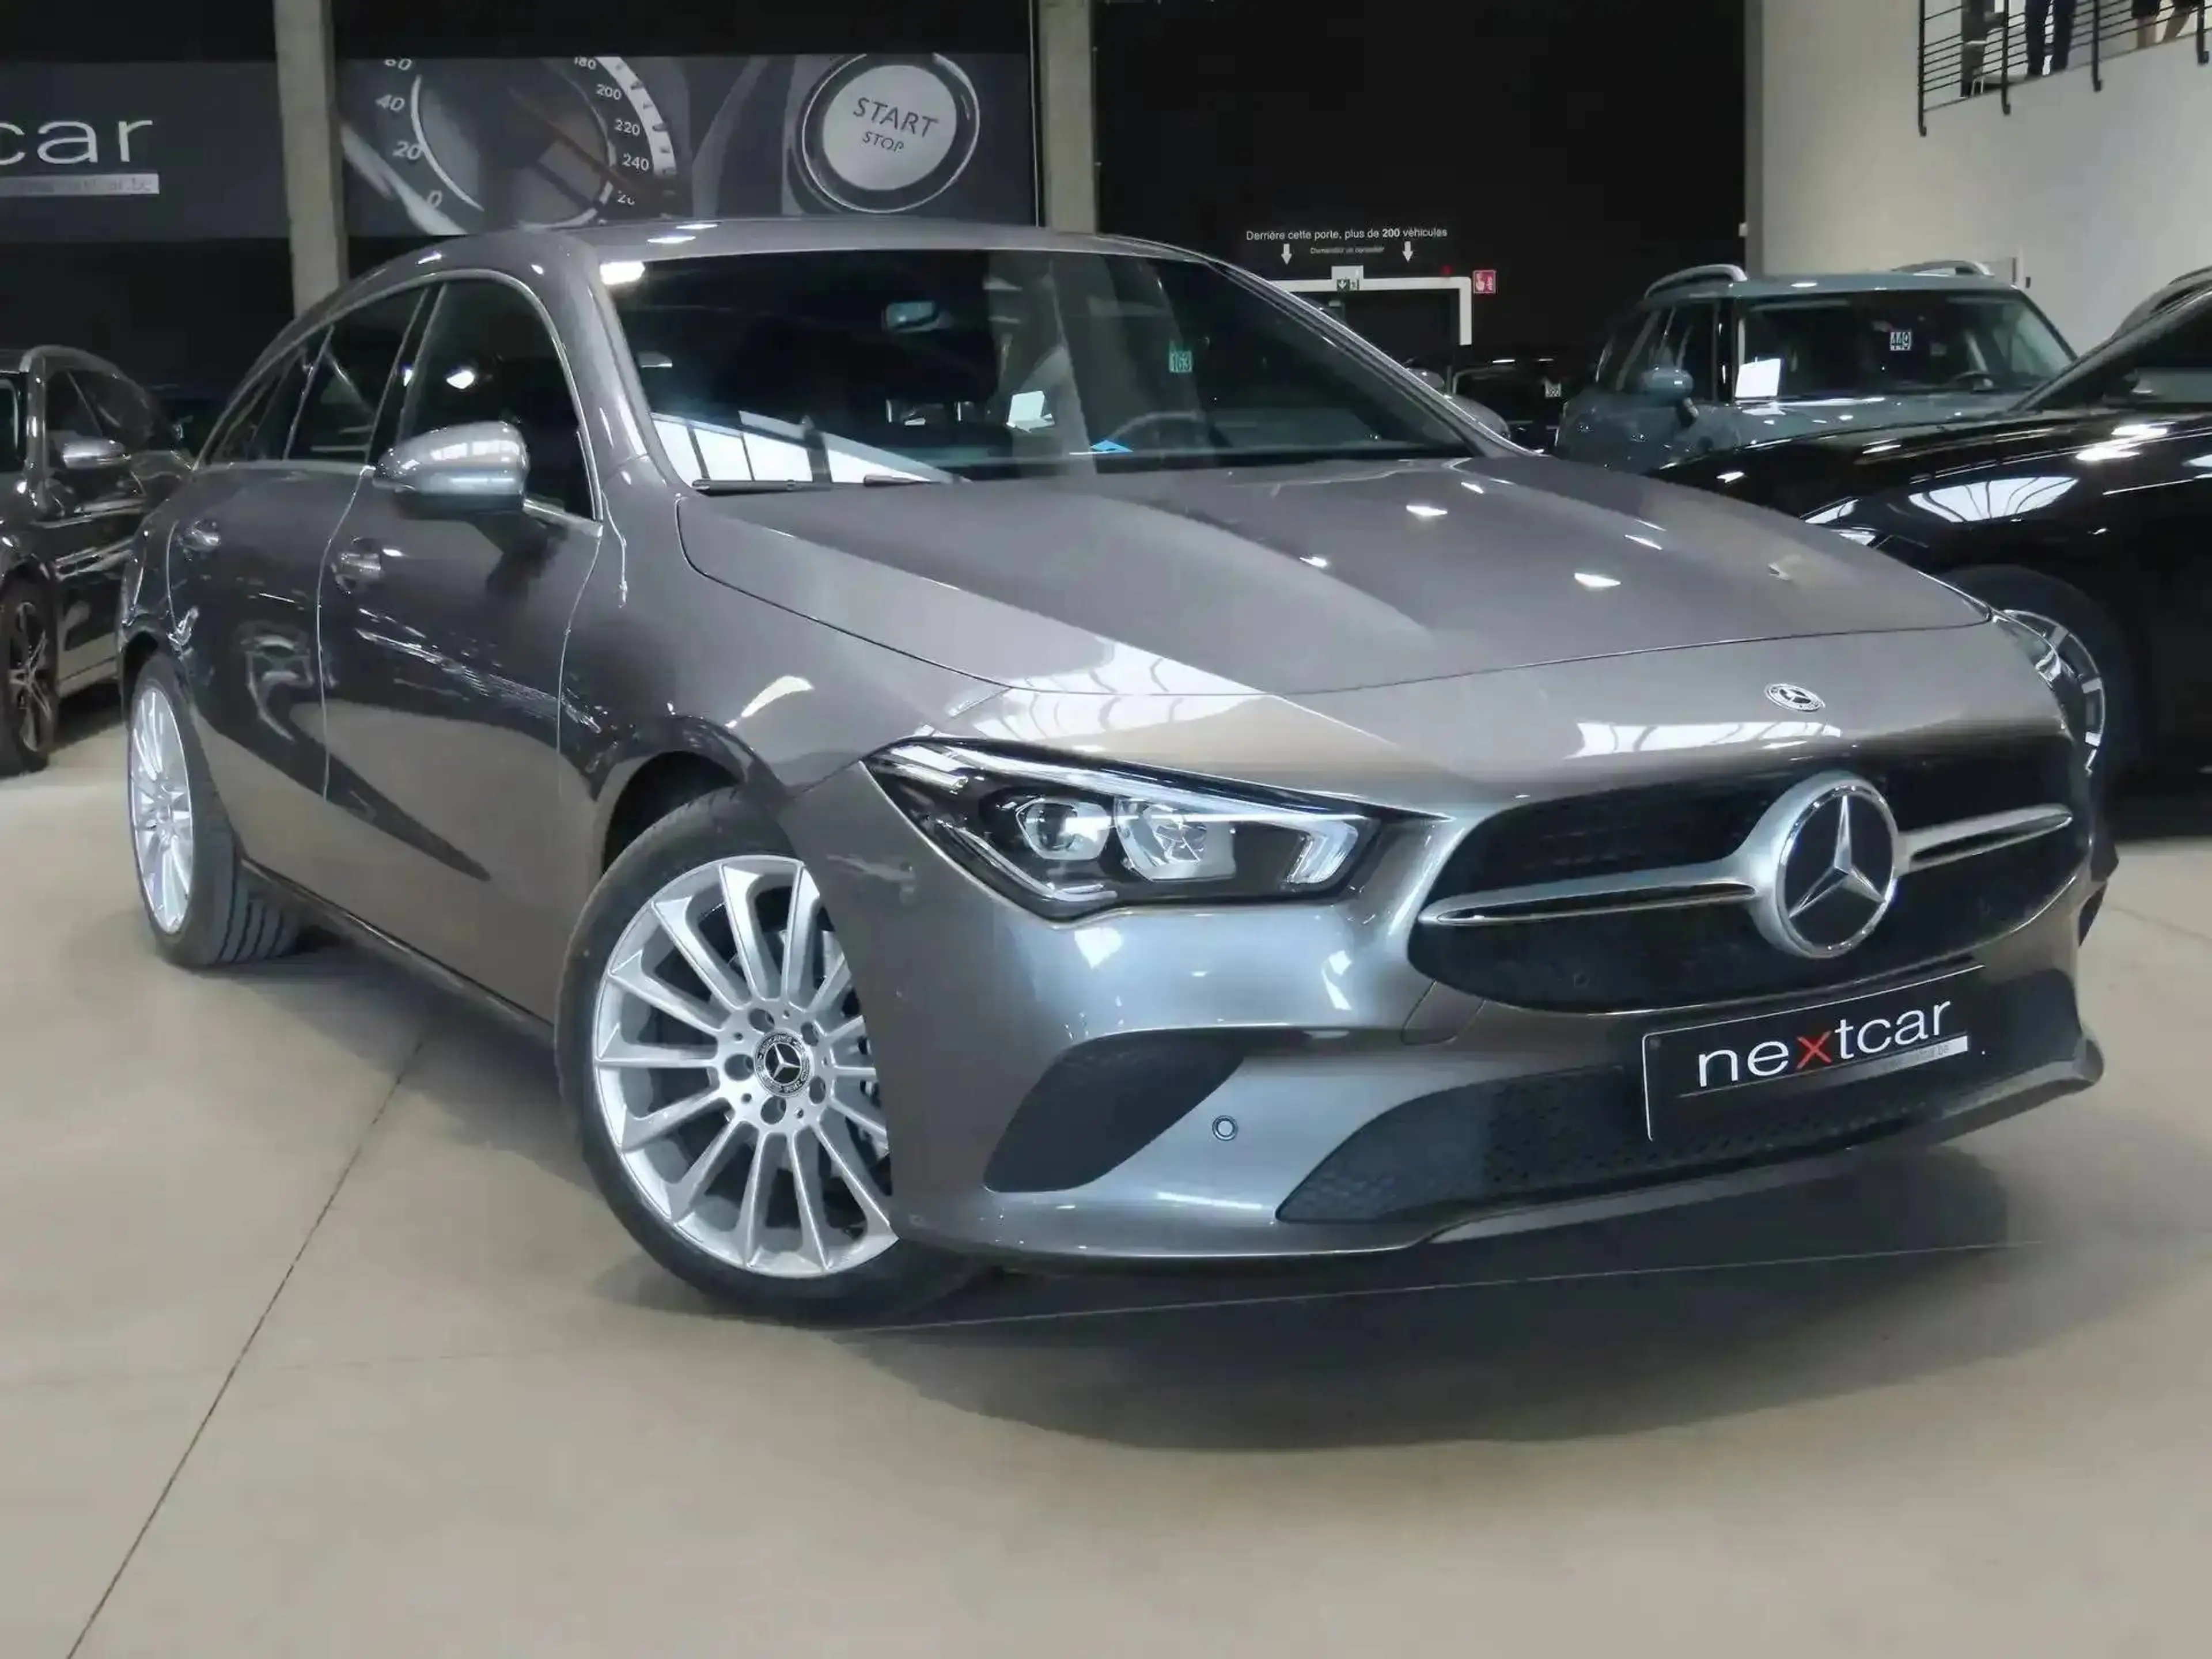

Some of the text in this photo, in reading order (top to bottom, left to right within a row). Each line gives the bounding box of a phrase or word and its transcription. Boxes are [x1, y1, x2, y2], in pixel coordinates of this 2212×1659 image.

[595, 84, 622, 100] 200
[376, 94, 405, 111] 40
[853, 97, 940, 138] START
[614, 119, 641, 136] 220
[393, 141, 422, 160] 20
[862, 131, 904, 152] STOP
[623, 152, 650, 171] 240
[427, 190, 443, 209] 0
[1287, 230, 1312, 240] cette
[1344, 229, 1365, 240] plus
[1367, 228, 1380, 238] de
[1382, 228, 1400, 238] 200
[1698, 1000, 1952, 1087] nextcar
